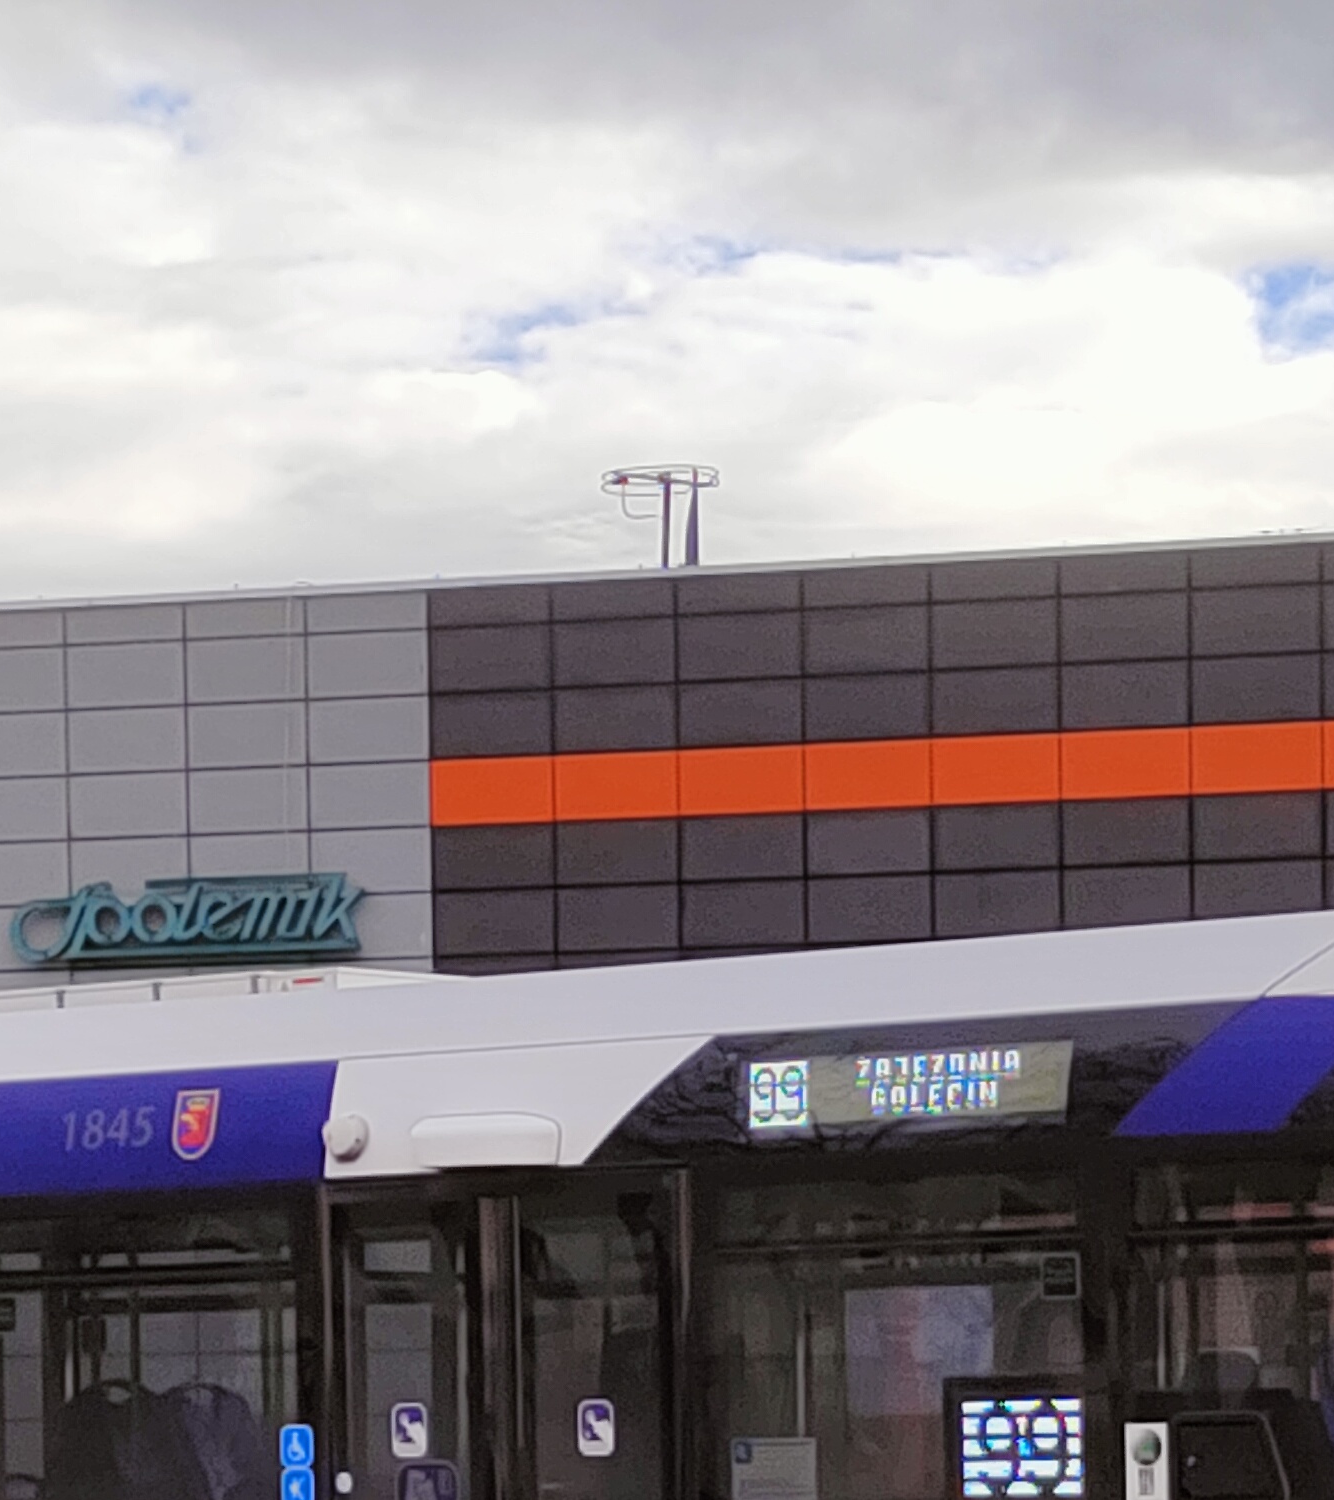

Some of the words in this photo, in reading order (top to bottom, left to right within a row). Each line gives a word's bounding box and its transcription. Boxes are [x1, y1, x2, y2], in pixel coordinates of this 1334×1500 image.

[753, 1065, 805, 1123] 99
[63, 1105, 156, 1151] 1845
[977, 1399, 1067, 1494] 99
